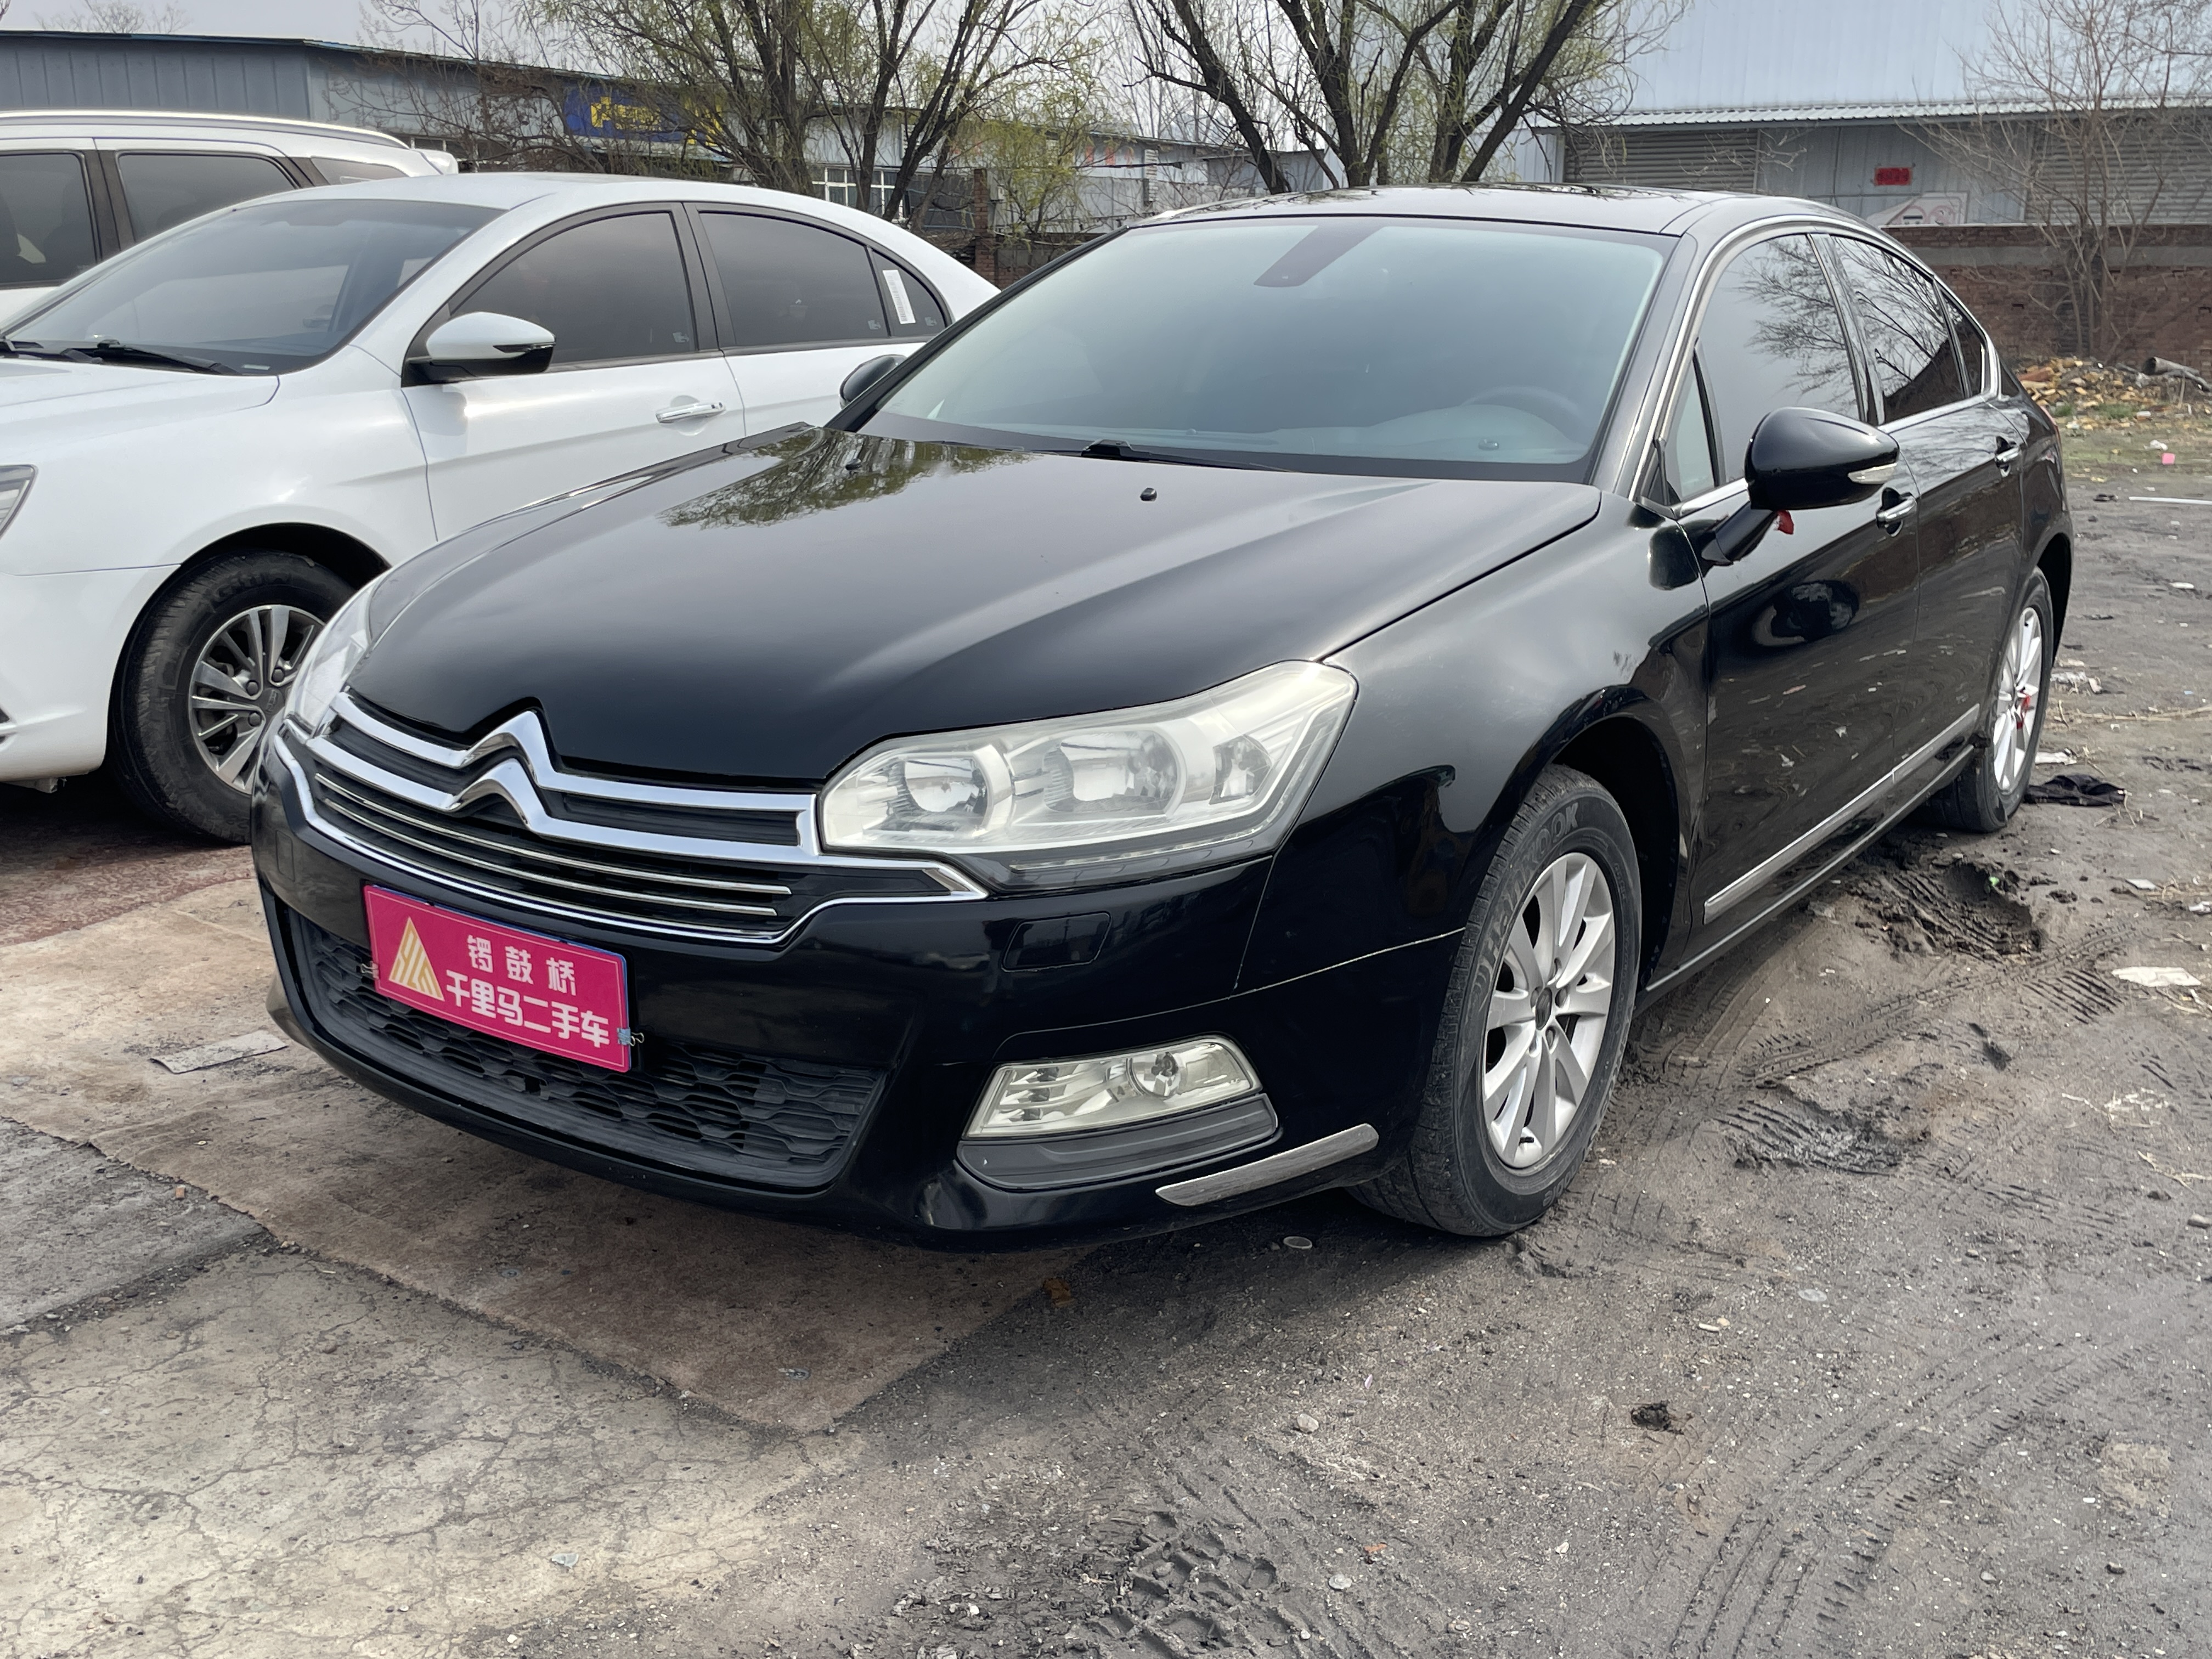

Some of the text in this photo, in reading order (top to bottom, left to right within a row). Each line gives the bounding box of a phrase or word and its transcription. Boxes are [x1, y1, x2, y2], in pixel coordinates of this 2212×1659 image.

[467, 934, 576, 996] 锣鼓桥
[445, 969, 610, 1048] 千里马二手车
